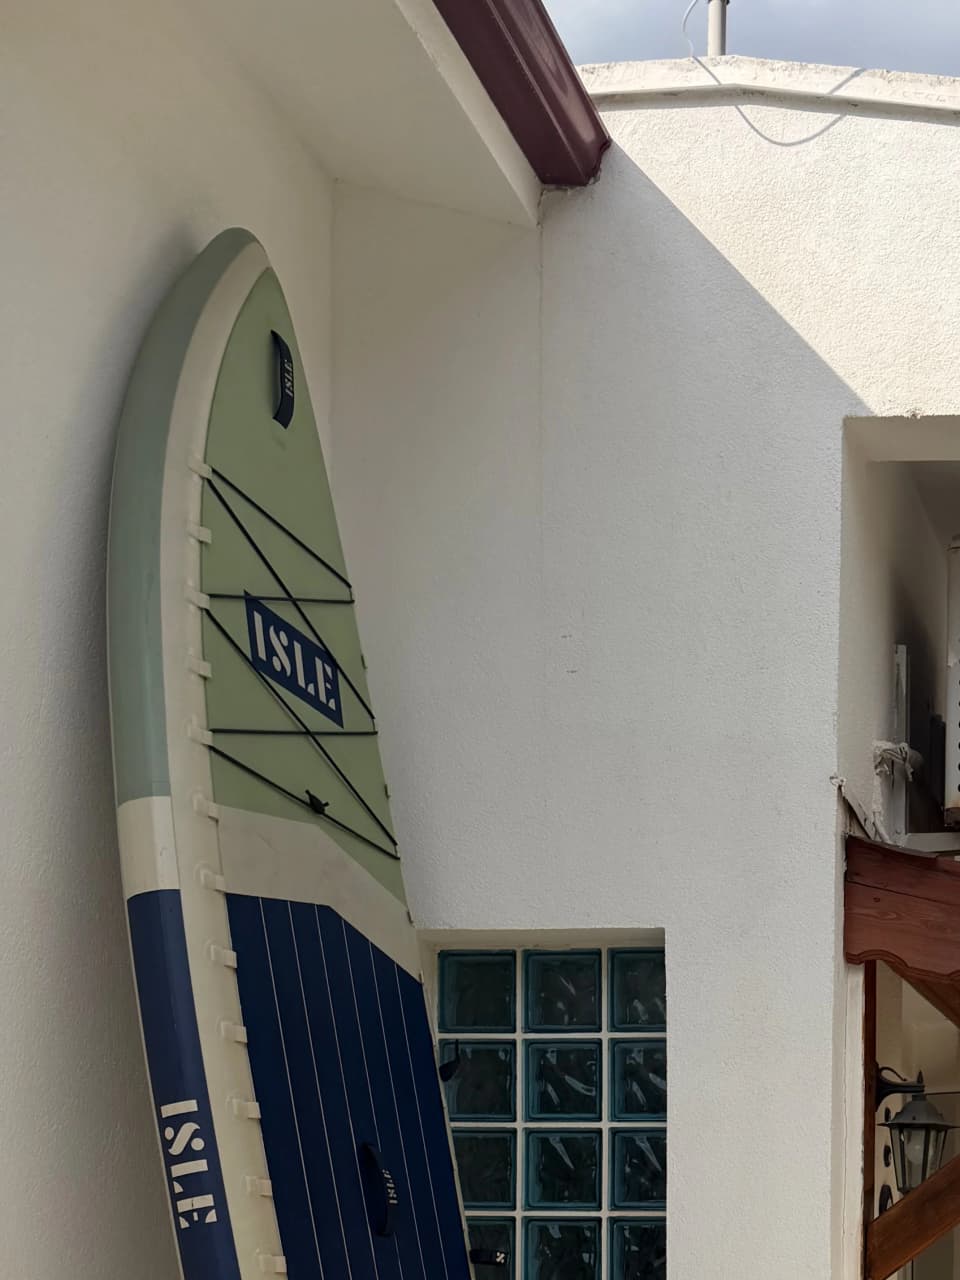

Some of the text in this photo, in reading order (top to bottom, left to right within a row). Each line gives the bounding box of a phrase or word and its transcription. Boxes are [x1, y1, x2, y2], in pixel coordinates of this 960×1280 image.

[284, 359, 294, 397] ISLE
[253, 610, 336, 711] ISLE
[160, 1099, 217, 1230] ISLE
[382, 1169, 398, 1204] ISLE
